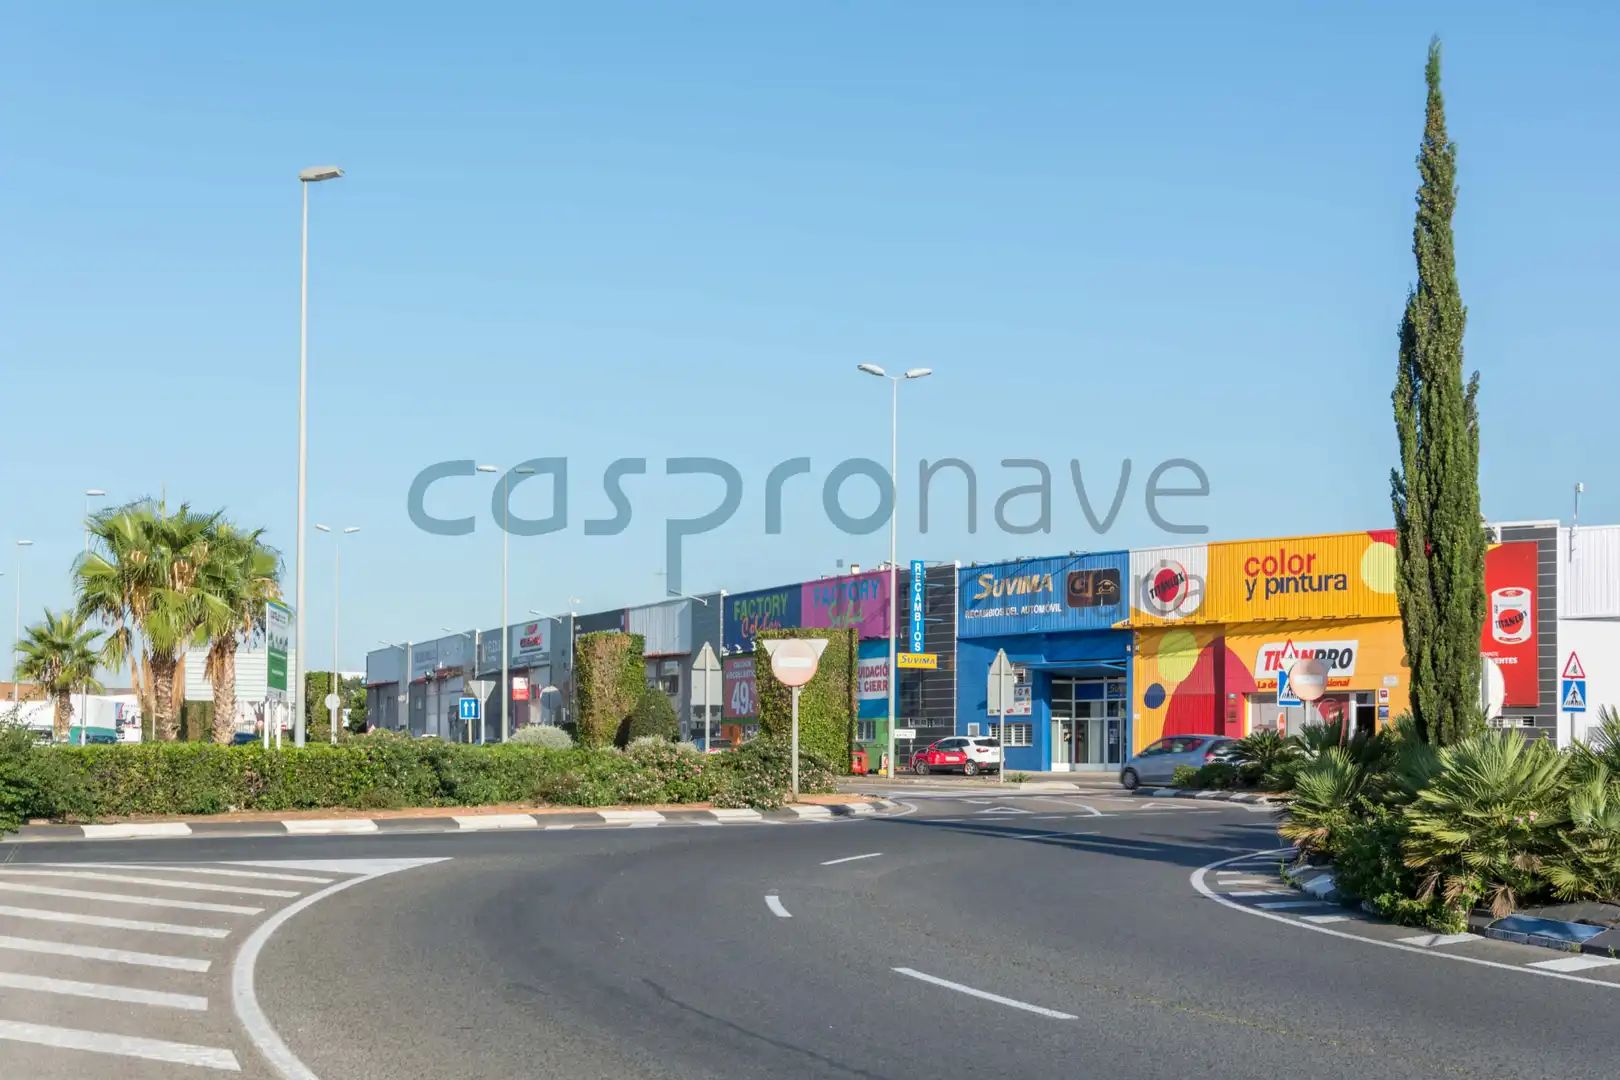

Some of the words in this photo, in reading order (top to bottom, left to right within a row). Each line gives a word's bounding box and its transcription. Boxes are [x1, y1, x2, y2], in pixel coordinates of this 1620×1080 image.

[1244, 548, 1316, 577] color
[814, 577, 881, 608] FACTORY
[1245, 578, 1257, 601] y
[1265, 572, 1347, 600] pintura
[733, 592, 788, 621] FACTORY
[913, 562, 922, 652] RECAMBIOS
[965, 607, 1004, 619] RECAMBIOS
[1005, 606, 1019, 617] DEL
